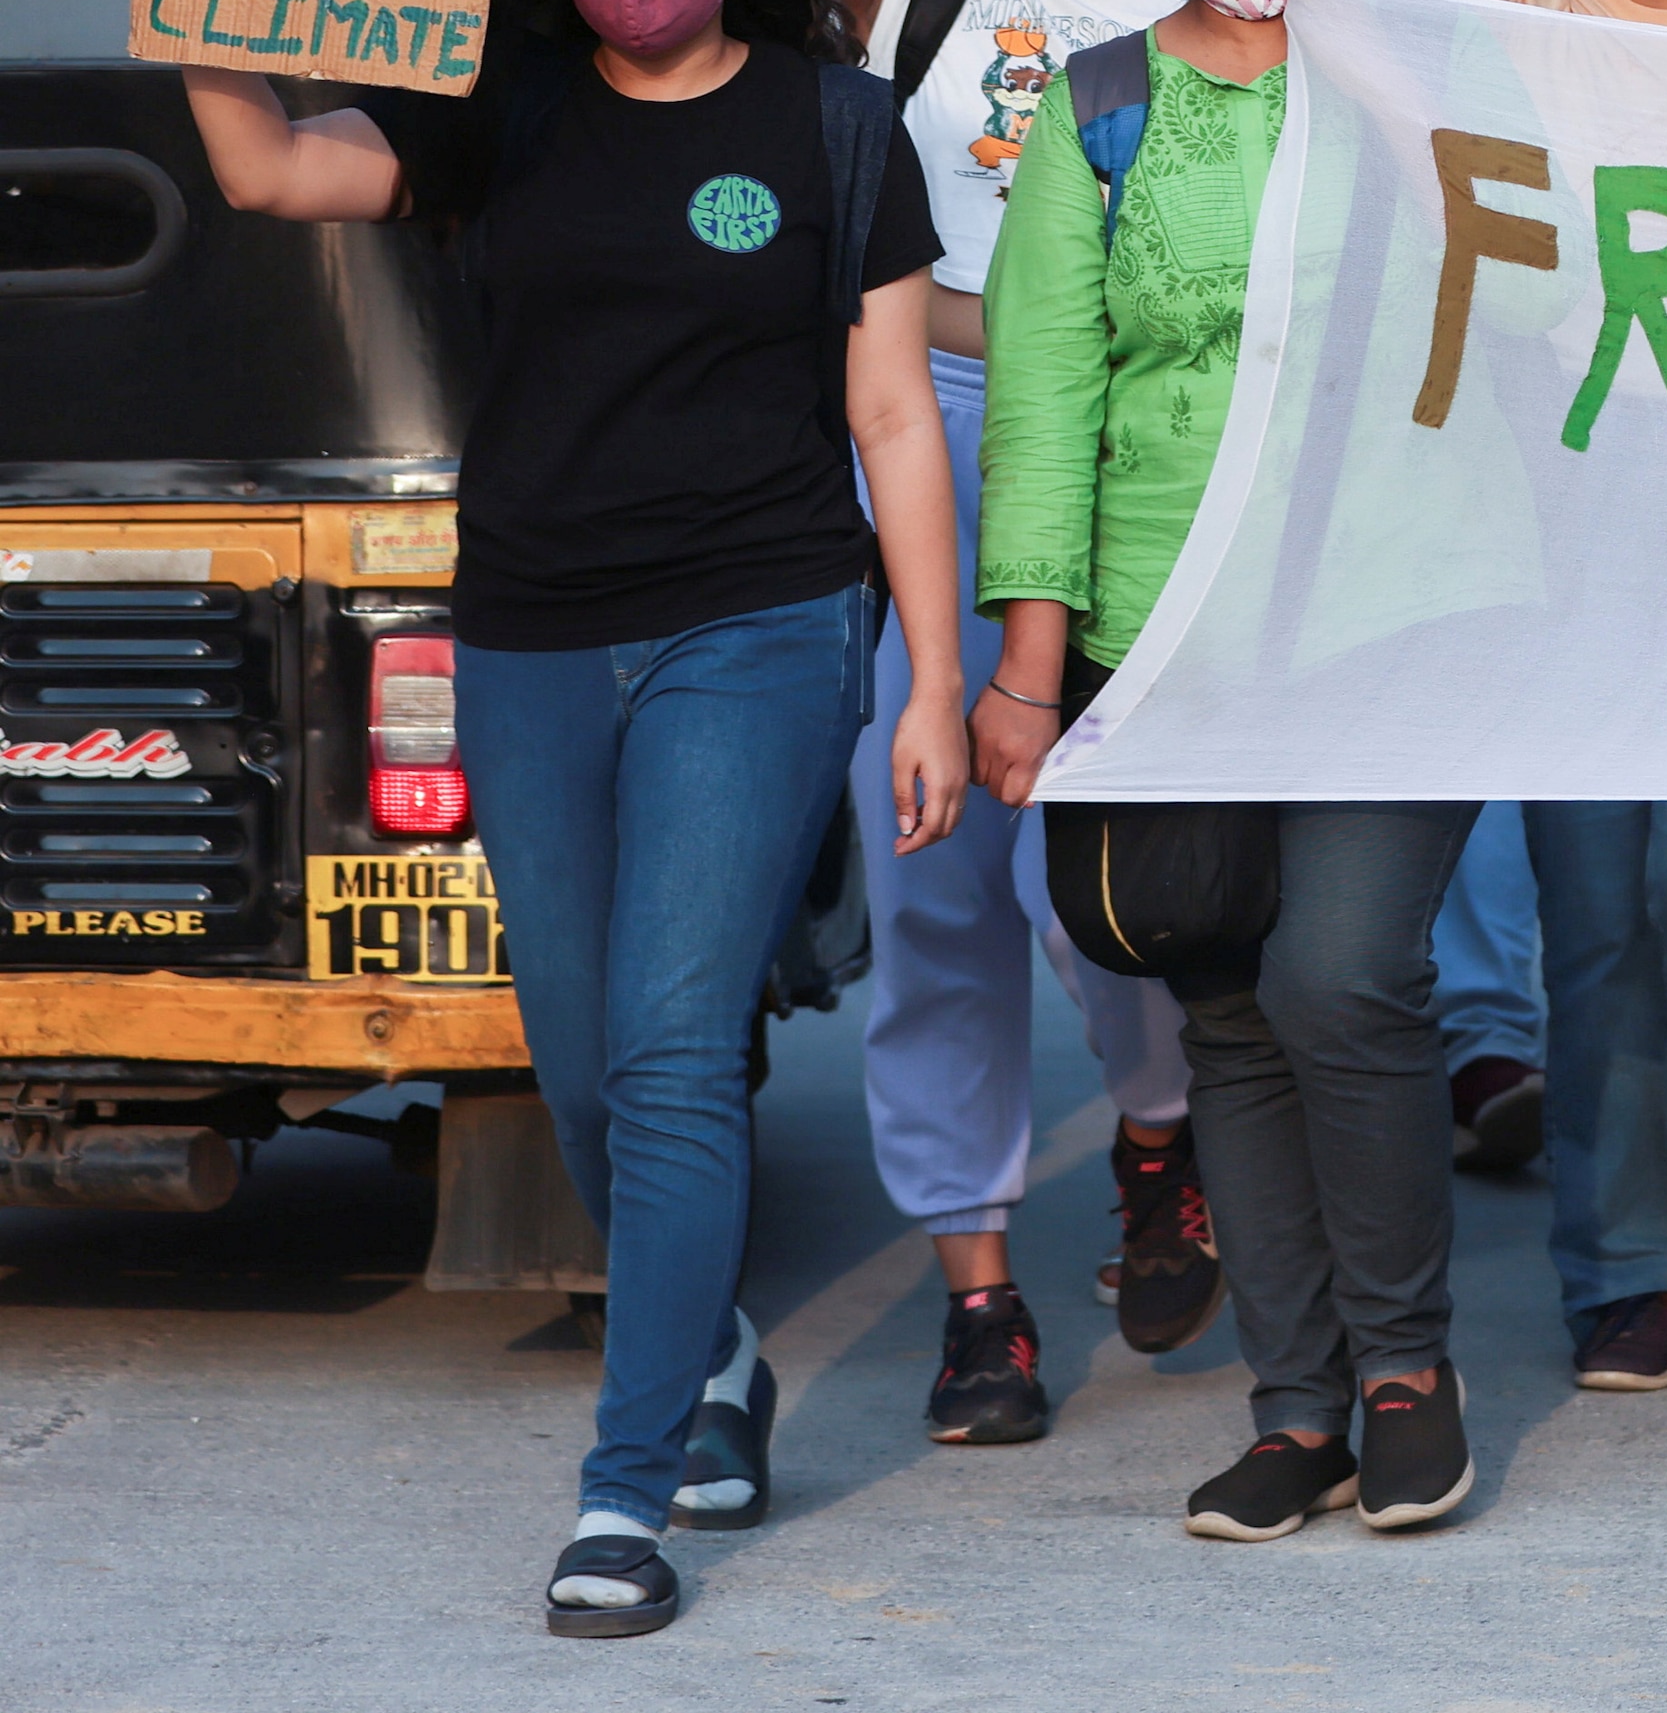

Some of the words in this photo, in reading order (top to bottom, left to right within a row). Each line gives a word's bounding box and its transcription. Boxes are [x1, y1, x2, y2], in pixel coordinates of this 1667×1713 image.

[693, 176, 776, 219] EARTH
[689, 206, 780, 251] FIRST
[0, 727, 193, 780] abh
[12, 910, 208, 938] PLEASE
[315, 902, 513, 976] 190
